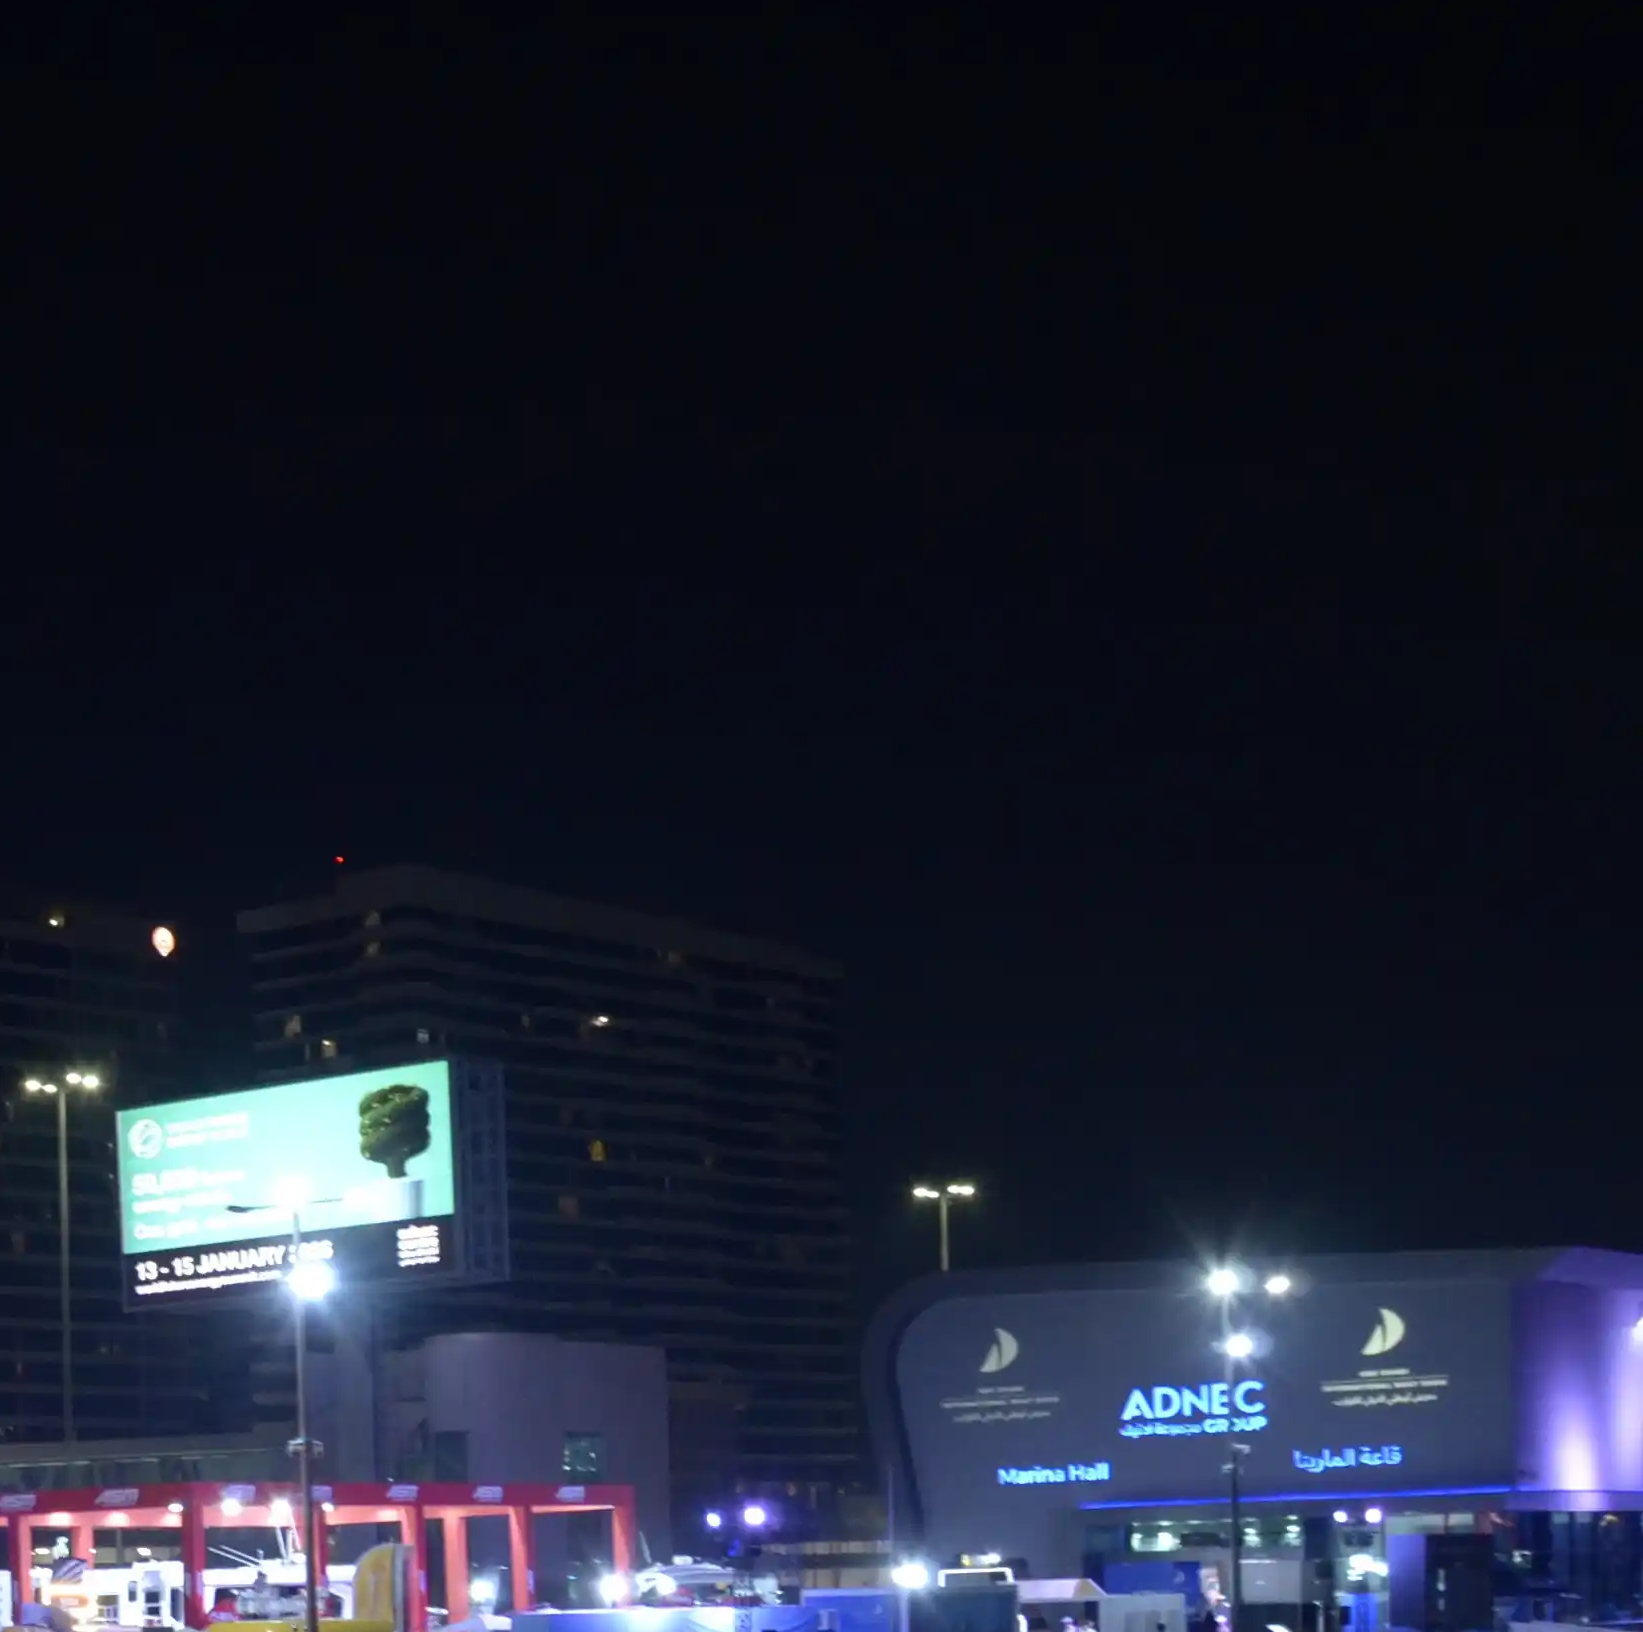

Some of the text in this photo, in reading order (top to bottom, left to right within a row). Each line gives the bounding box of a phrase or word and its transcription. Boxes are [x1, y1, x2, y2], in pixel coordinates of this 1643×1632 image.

[135, 1260, 158, 1281] 13
[171, 1256, 194, 1276] 15
[196, 1245, 286, 1274] JANUARY
[1120, 1380, 1266, 1421] ADNEC
[997, 1462, 1110, 1485] Marina Hall
